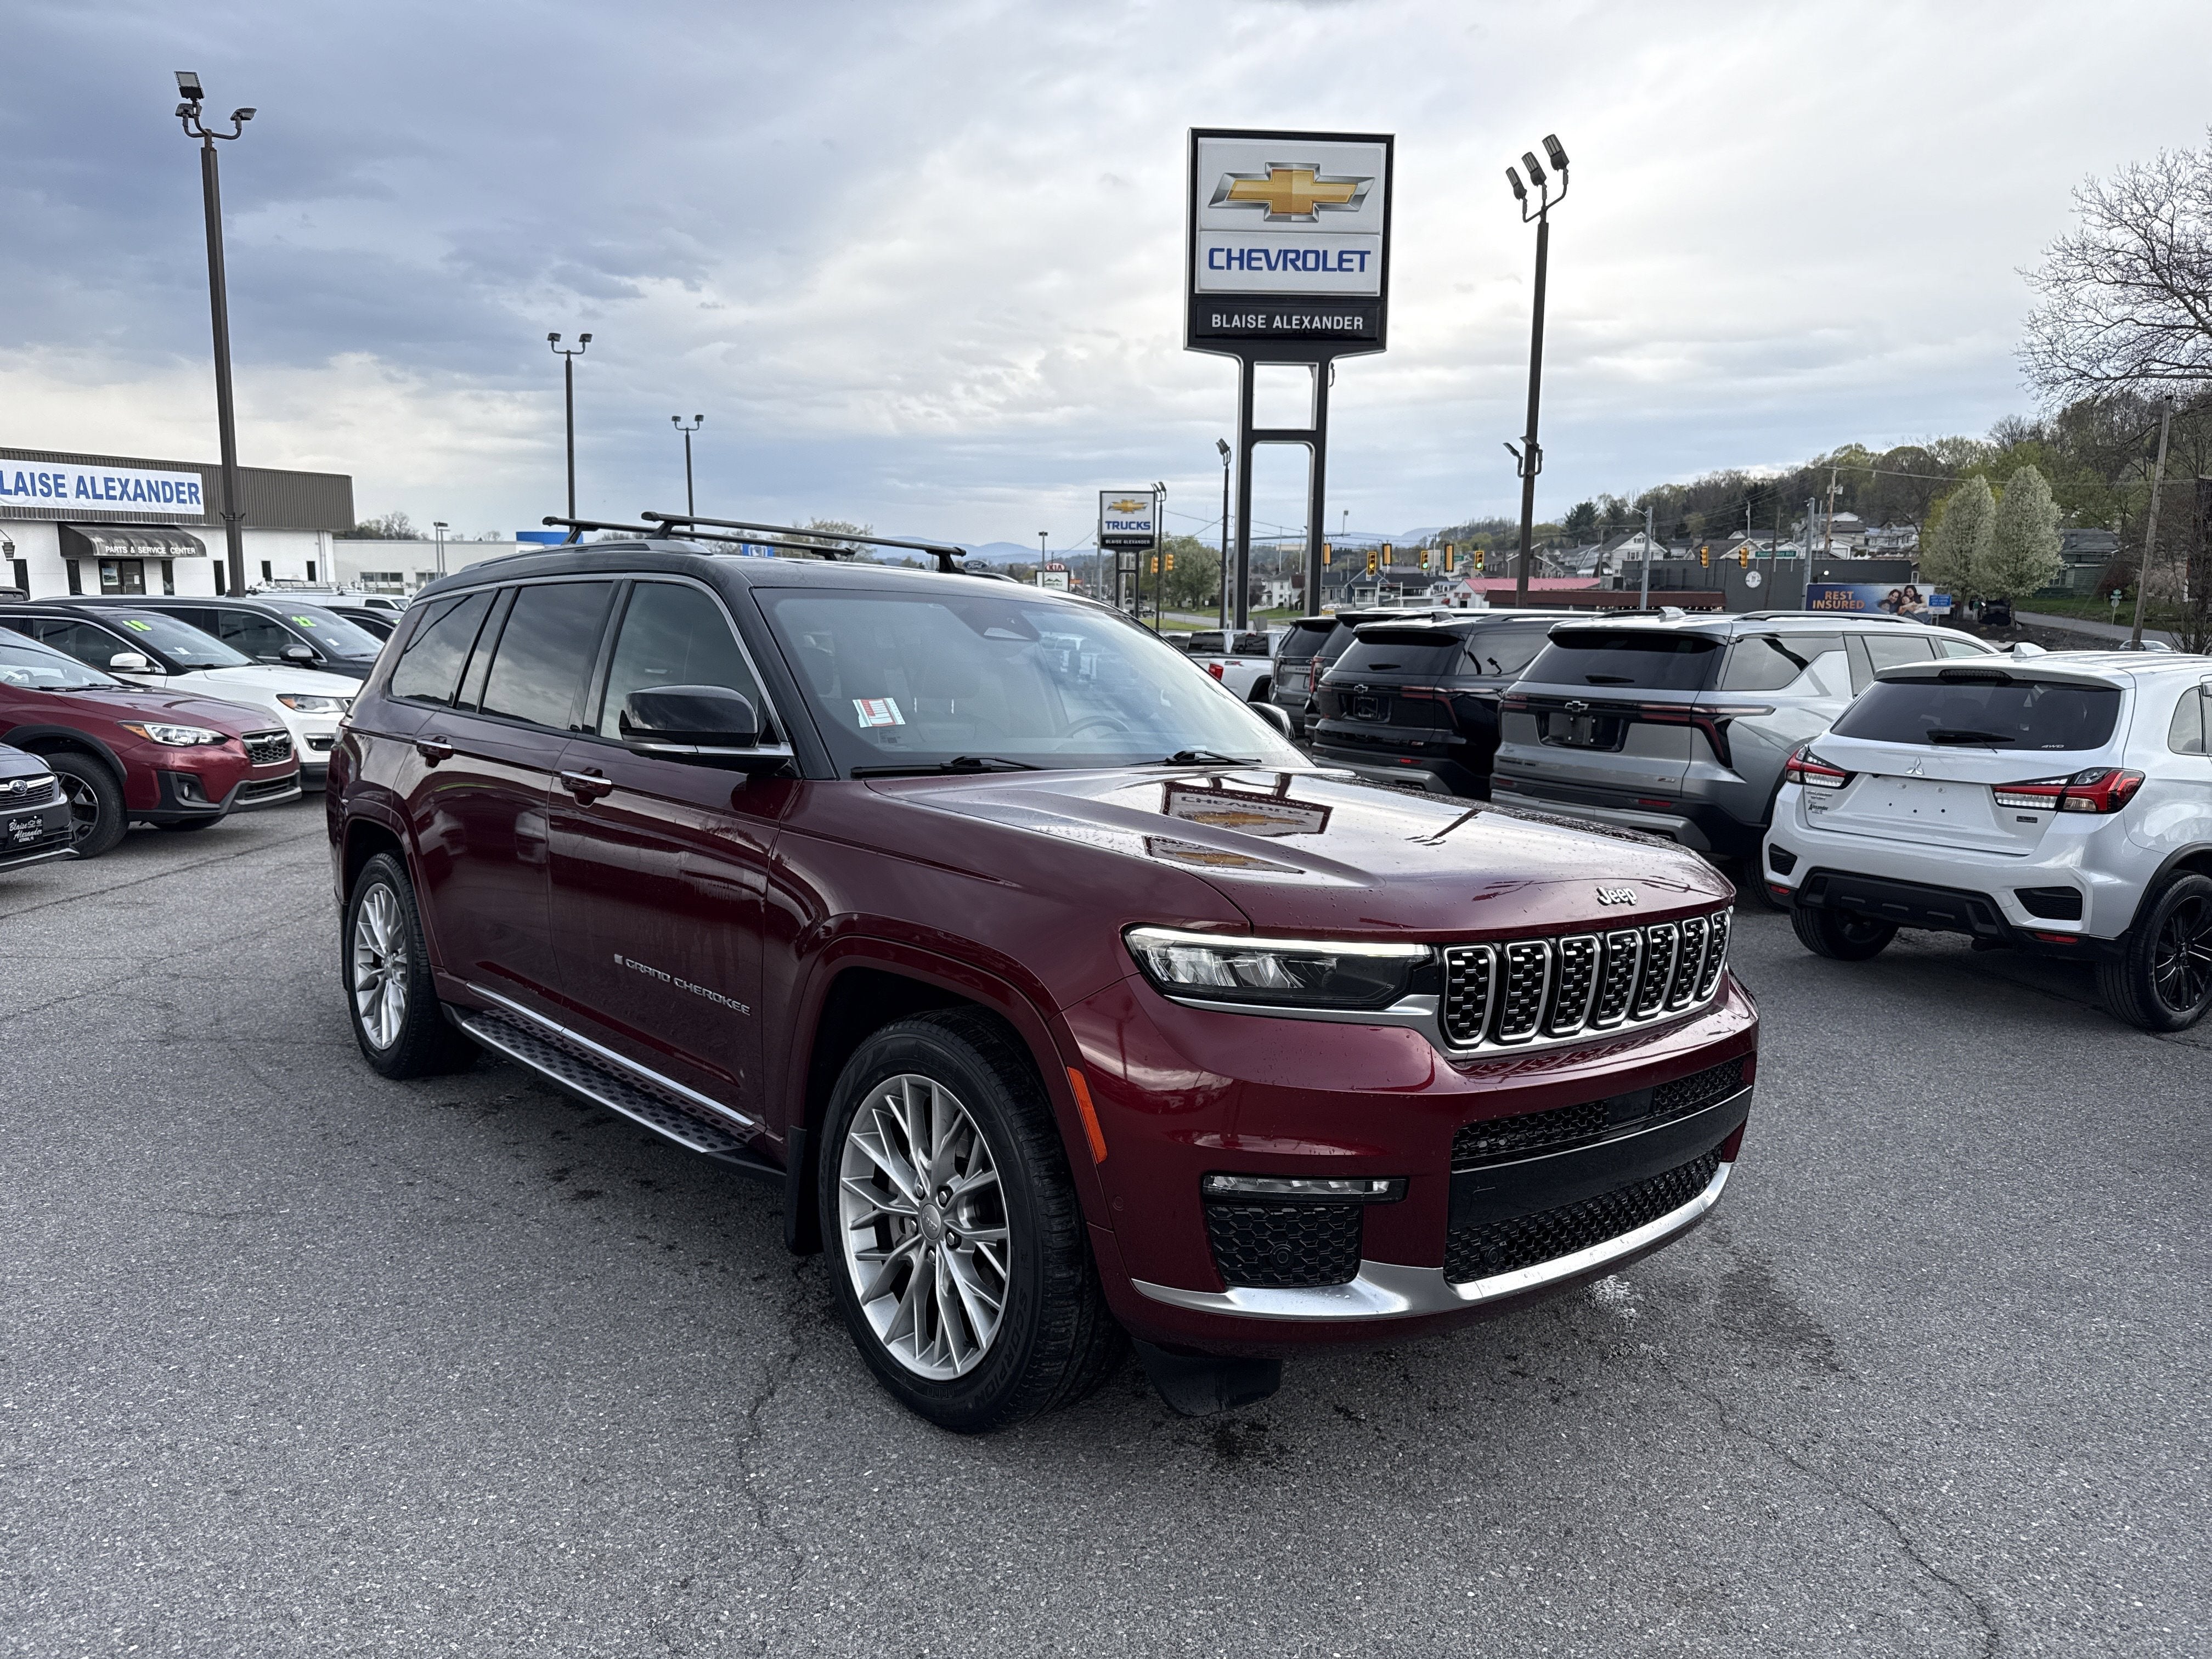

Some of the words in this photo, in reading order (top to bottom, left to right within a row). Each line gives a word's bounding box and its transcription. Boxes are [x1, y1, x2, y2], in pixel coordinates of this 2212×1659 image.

[1209, 248, 1371, 272] CHEVROLET
[1212, 314, 1266, 329] BLAISE
[1273, 315, 1363, 330] ALEXANDER
[75, 475, 201, 505] ALEXANDER
[1105, 521, 1150, 531] TRUCKS
[105, 546, 128, 554] PARTS
[138, 546, 166, 555] SERVICE
[170, 547, 196, 555] CENTER
[1825, 591, 1854, 600] REST
[1812, 600, 1865, 610] INSURED
[9, 822, 27, 832] Blaise
[13, 827, 42, 840] Alexander
[1596, 887, 1637, 906] Jeep
[625, 958, 670, 983] GRAND
[673, 978, 751, 1016] CHEROKEE
[922, 1212, 938, 1231] Jeep
[976, 1290, 1027, 1407] SCORPION
